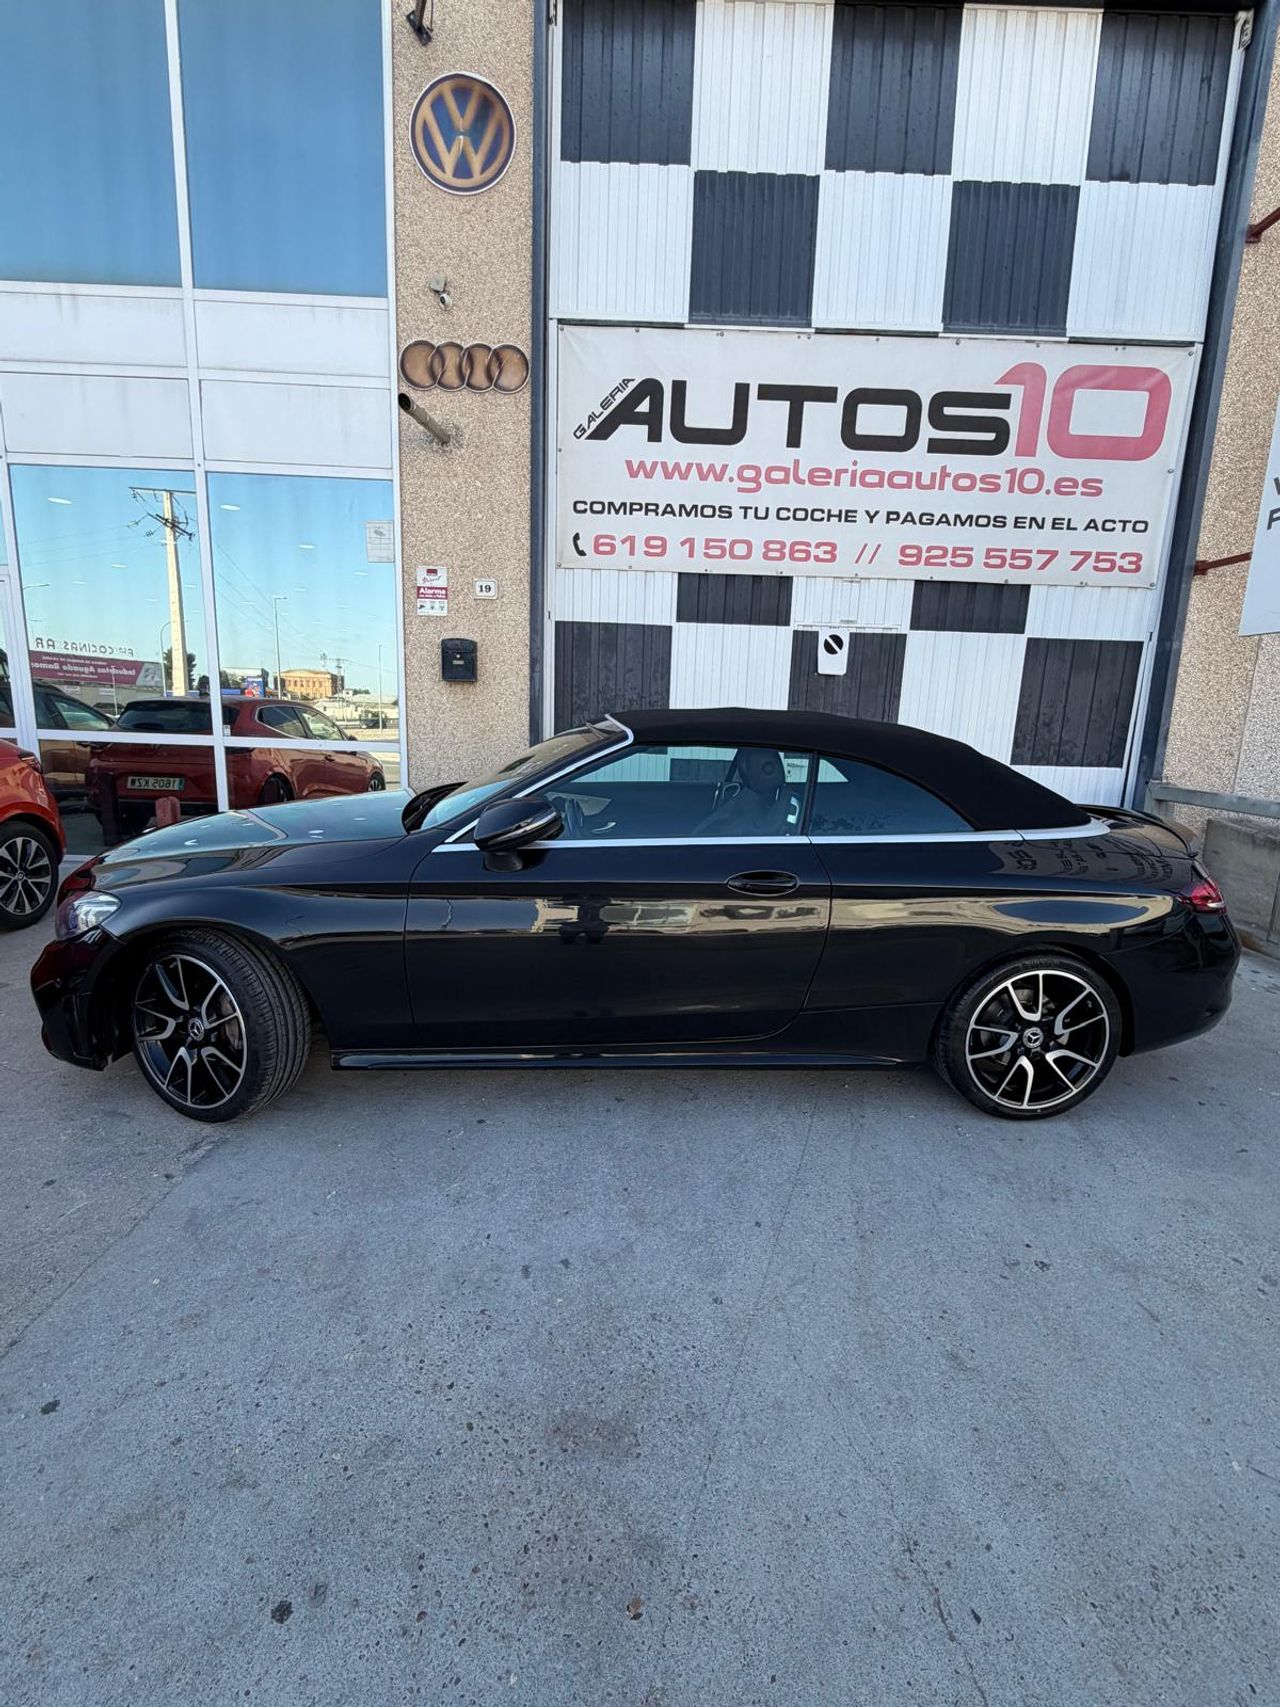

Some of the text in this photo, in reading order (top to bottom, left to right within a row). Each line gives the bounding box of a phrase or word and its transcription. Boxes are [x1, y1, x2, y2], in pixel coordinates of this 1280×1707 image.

[573, 378, 636, 440] GALERIA
[584, 361, 1172, 462] AUTOS10
[624, 458, 1104, 497] www.galeriaautos10.es
[572, 500, 1149, 534] COMPRAMOS TU COCHE Y PAGAMOS EN EL ACTO
[593, 534, 668, 557] 619
[679, 537, 754, 560] 150
[762, 540, 838, 563] 863
[898, 544, 974, 568] 925
[983, 548, 1060, 571] 557
[1069, 551, 1143, 574] 753
[419, 587, 446, 595] Alarma
[479, 585, 492, 593] 19
